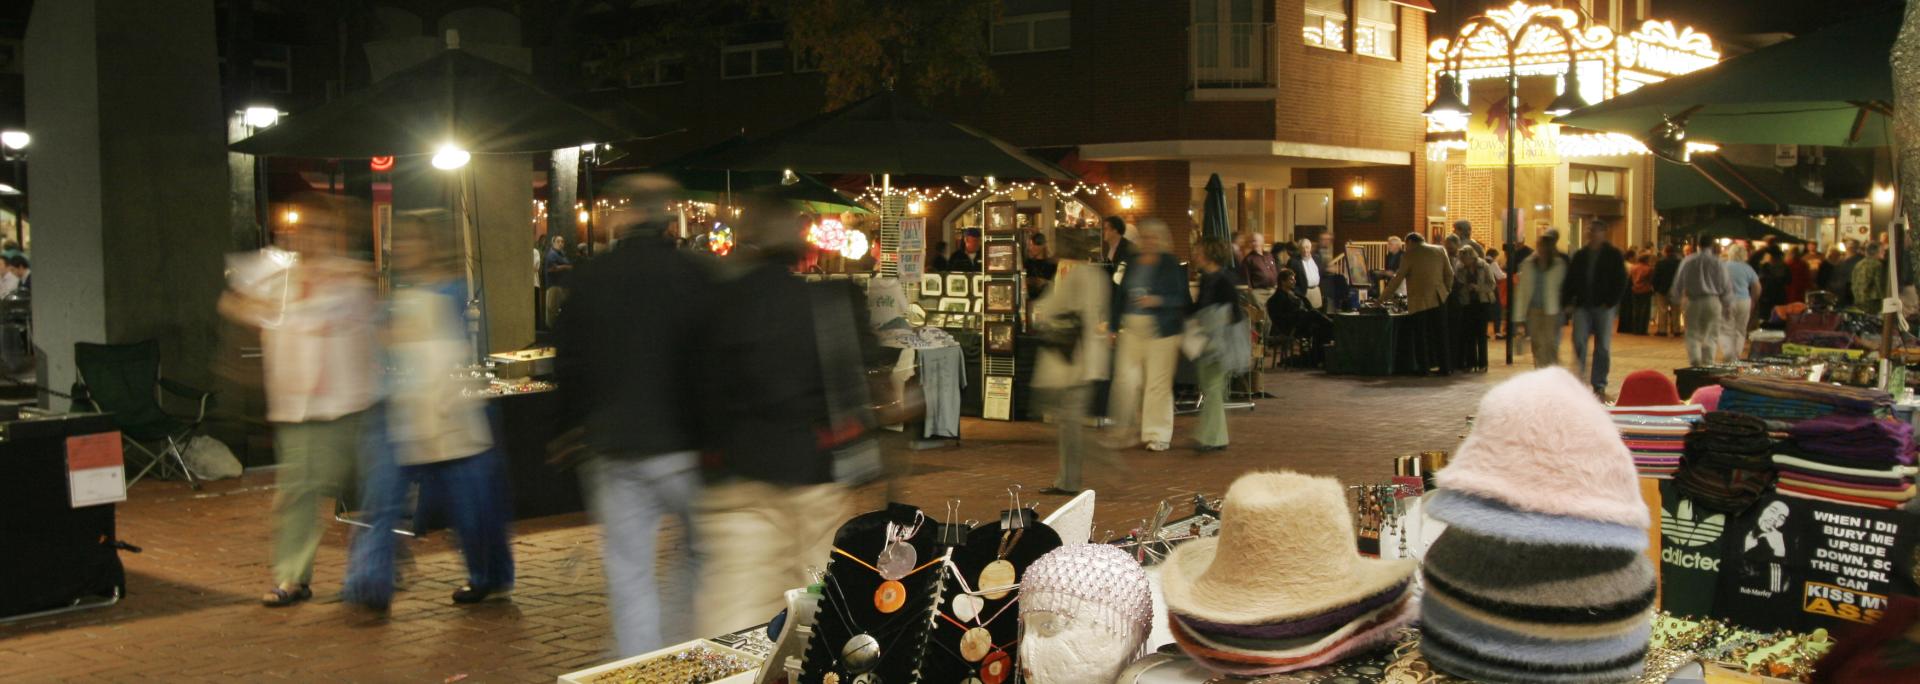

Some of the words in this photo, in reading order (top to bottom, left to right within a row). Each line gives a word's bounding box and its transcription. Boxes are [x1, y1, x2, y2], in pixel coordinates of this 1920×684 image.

[1814, 510, 1861, 527] WHEN
[1865, 519, 1871, 529] I
[1823, 525, 1867, 540] BURY
[1871, 533, 1894, 546] ME
[1828, 538, 1886, 557] UPSIDE
[1817, 548, 1868, 568] DOWN,
[1811, 559, 1840, 573] THE
[1842, 566, 1890, 583] WORL
[1836, 577, 1869, 591] CAN
[1808, 585, 1855, 604] KISS
[1806, 598, 1888, 625] ASS
